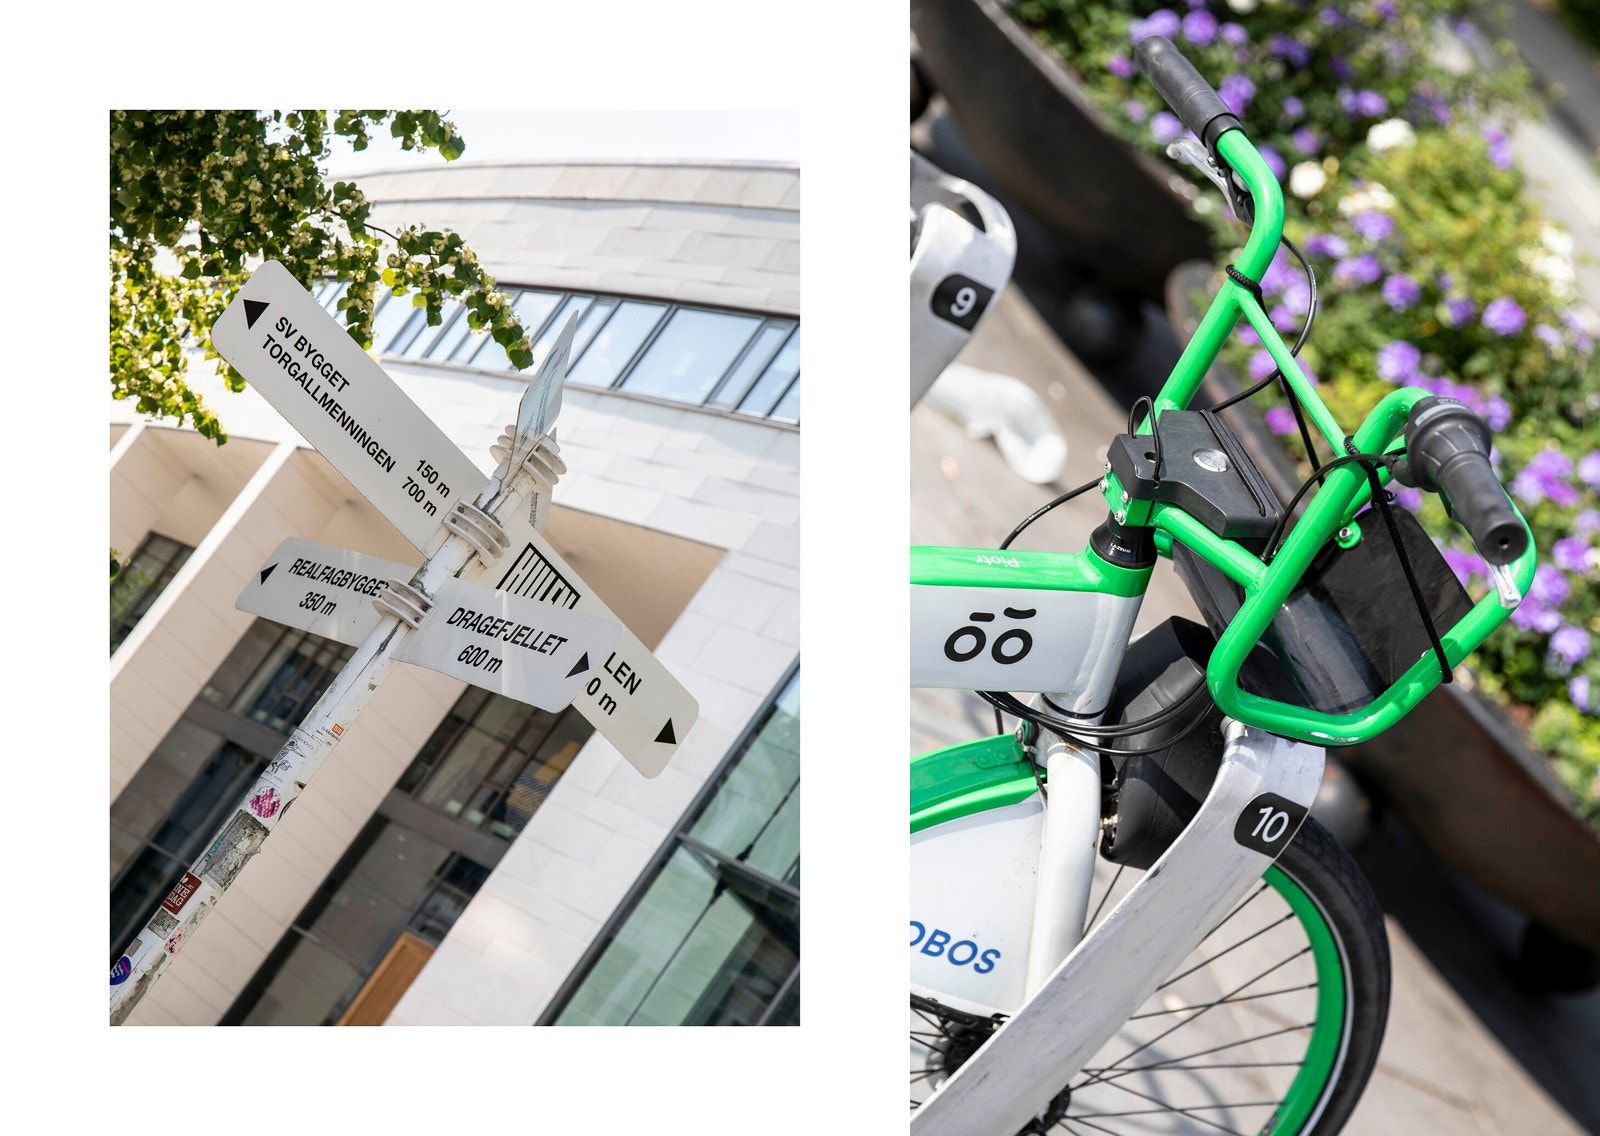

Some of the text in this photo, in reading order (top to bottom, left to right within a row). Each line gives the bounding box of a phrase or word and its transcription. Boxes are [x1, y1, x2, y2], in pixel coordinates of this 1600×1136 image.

[950, 286, 977, 318] 9
[262, 333, 437, 517] TORGALLMENNINGEN 700 m
[275, 316, 451, 499] SV BYGGET 150 m
[975, 554, 1020, 568] Piotr
[298, 591, 337, 616] 350 m
[446, 606, 568, 656] DRAGEFJELLET
[457, 644, 503, 673] 600 m
[603, 651, 642, 695] LEN
[585, 677, 617, 716] 0 m
[1251, 806, 1289, 842] 10
